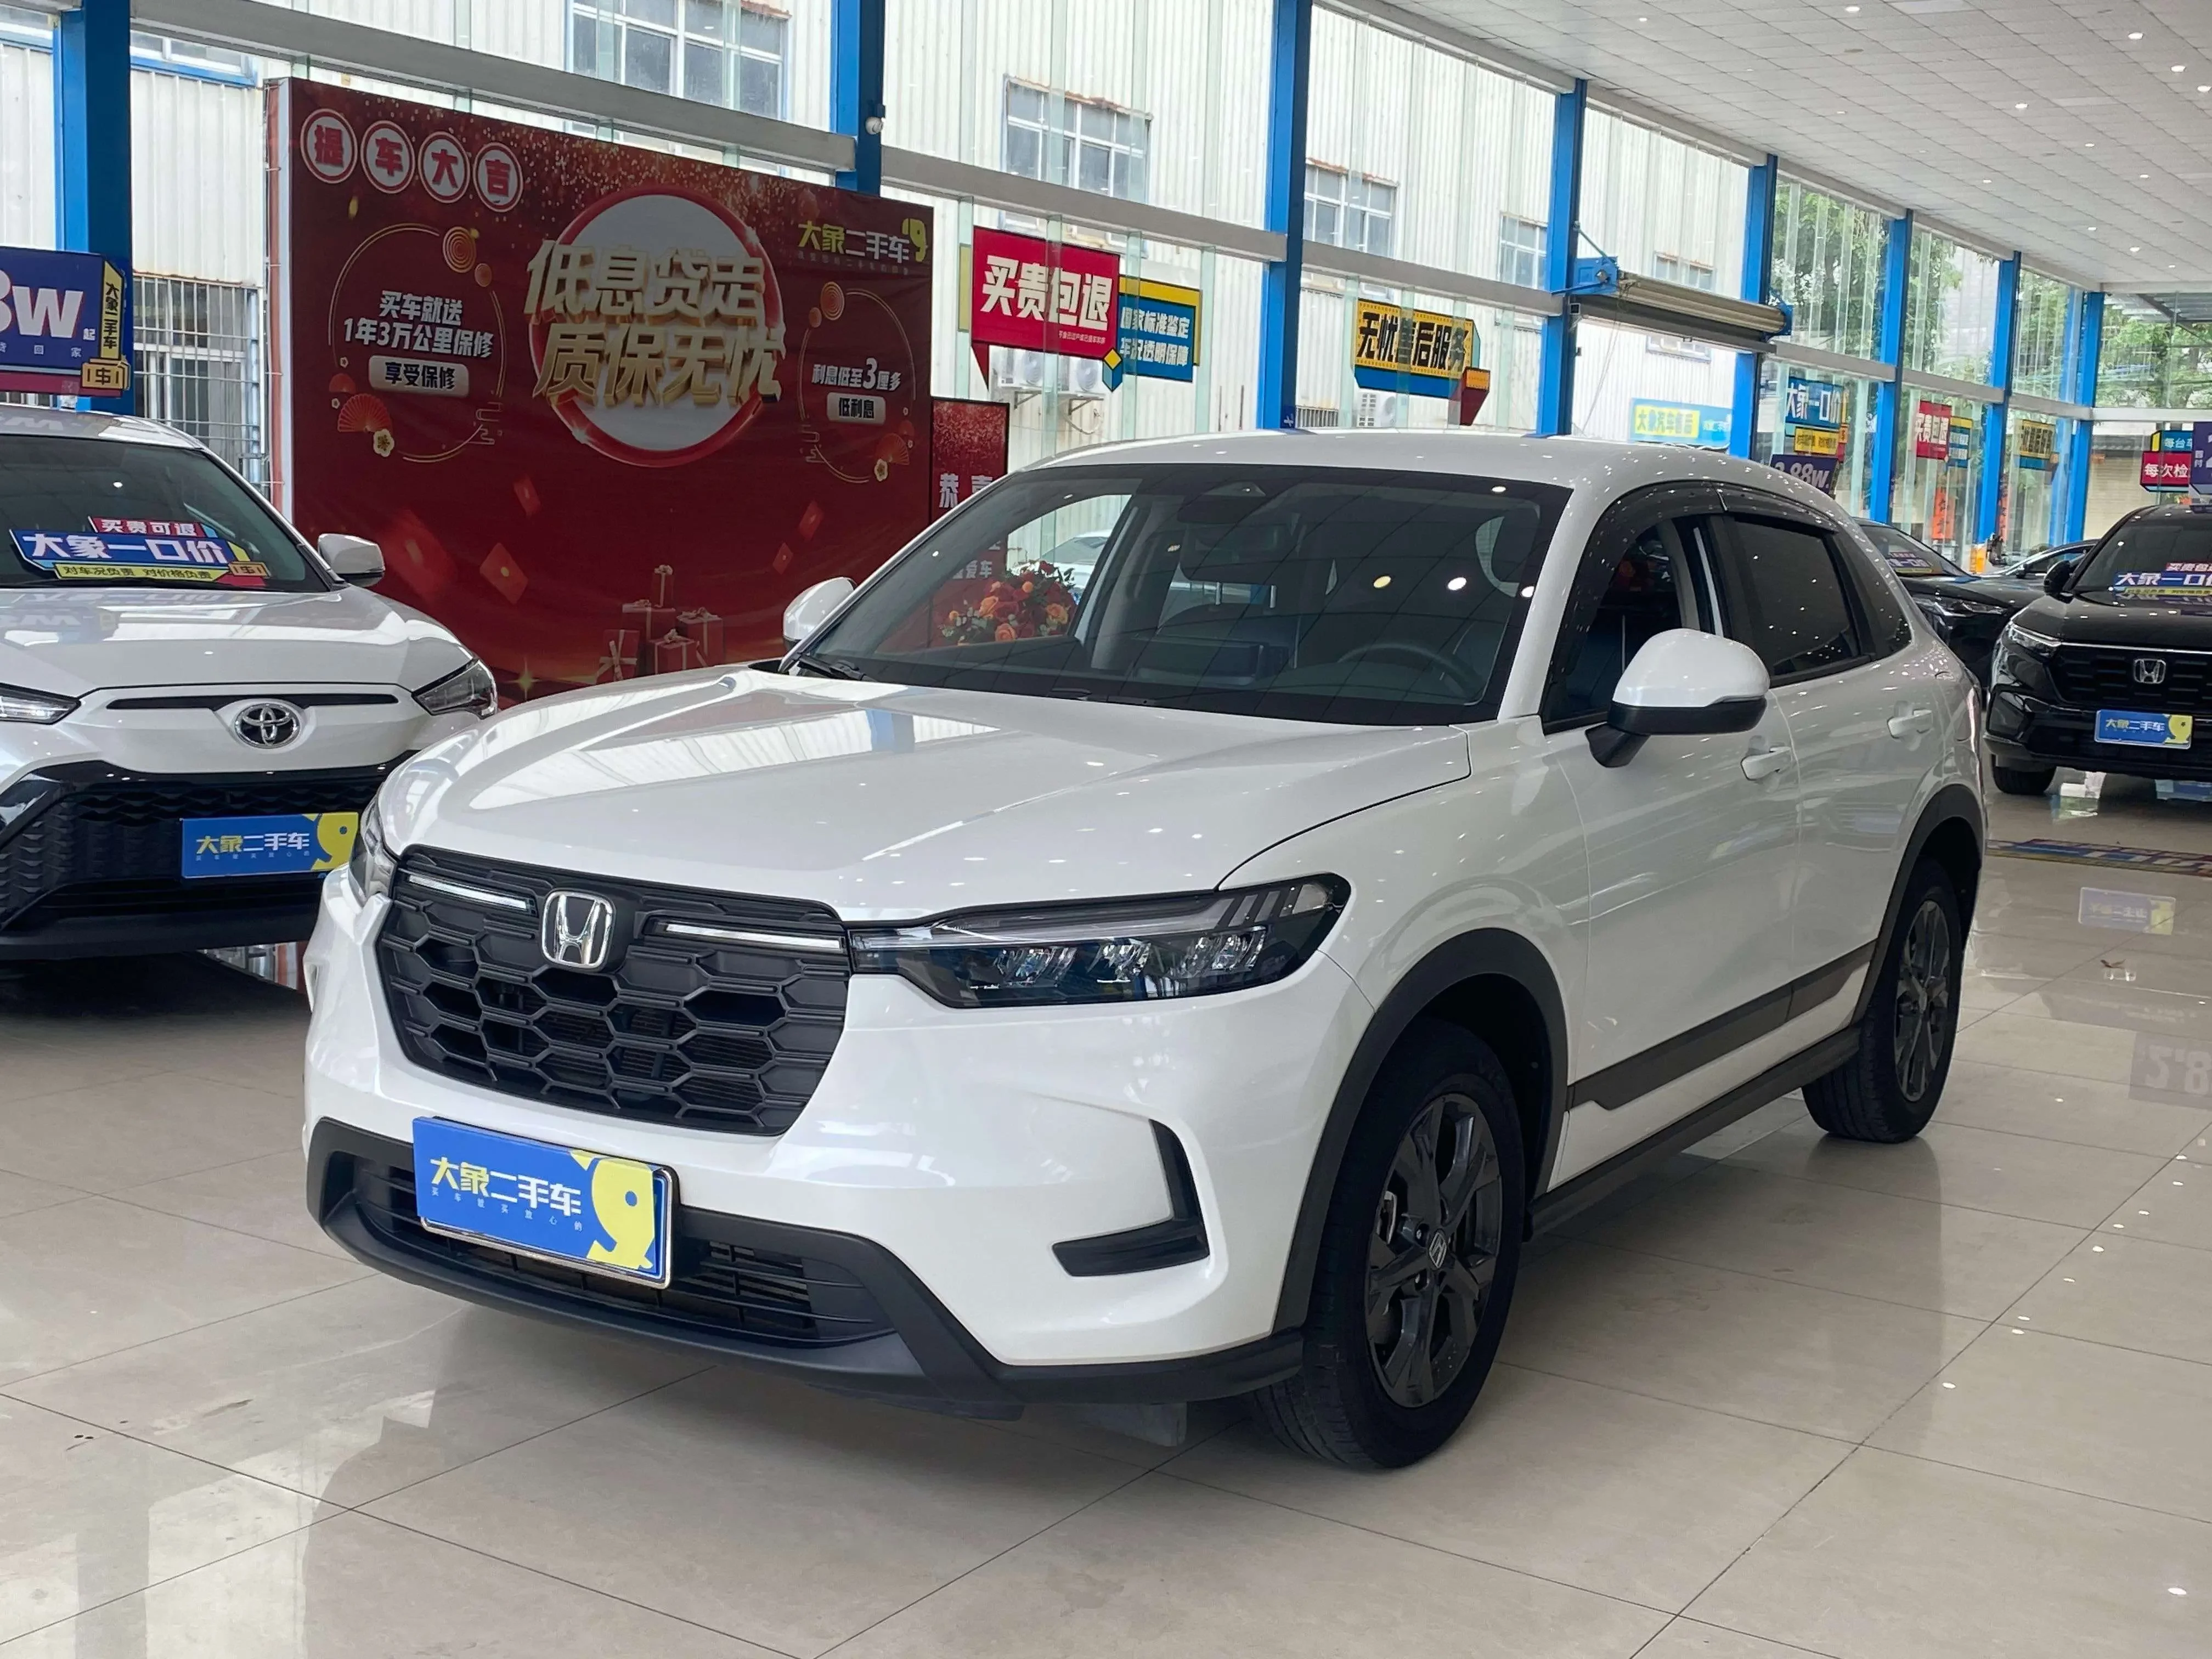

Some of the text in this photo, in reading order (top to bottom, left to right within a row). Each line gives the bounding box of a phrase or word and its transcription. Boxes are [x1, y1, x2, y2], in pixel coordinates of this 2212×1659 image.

[314, 125, 511, 198] 提车大吉
[798, 220, 910, 264] 大象二手车
[379, 290, 464, 326] 买车就送
[980, 255, 1113, 331] 买贵包退
[103, 281, 119, 349] 大象二手车
[343, 317, 494, 359] 1年3万公里保修
[385, 361, 455, 390] 享受保修
[532, 323, 786, 407] 质保无忧
[839, 397, 875, 419] 低利息
[22, 533, 228, 564] 大象一口价
[101, 518, 198, 537] 买贵可退
[196, 832, 309, 855] 大象二手车
[430, 1156, 582, 1217] 大象二手车
